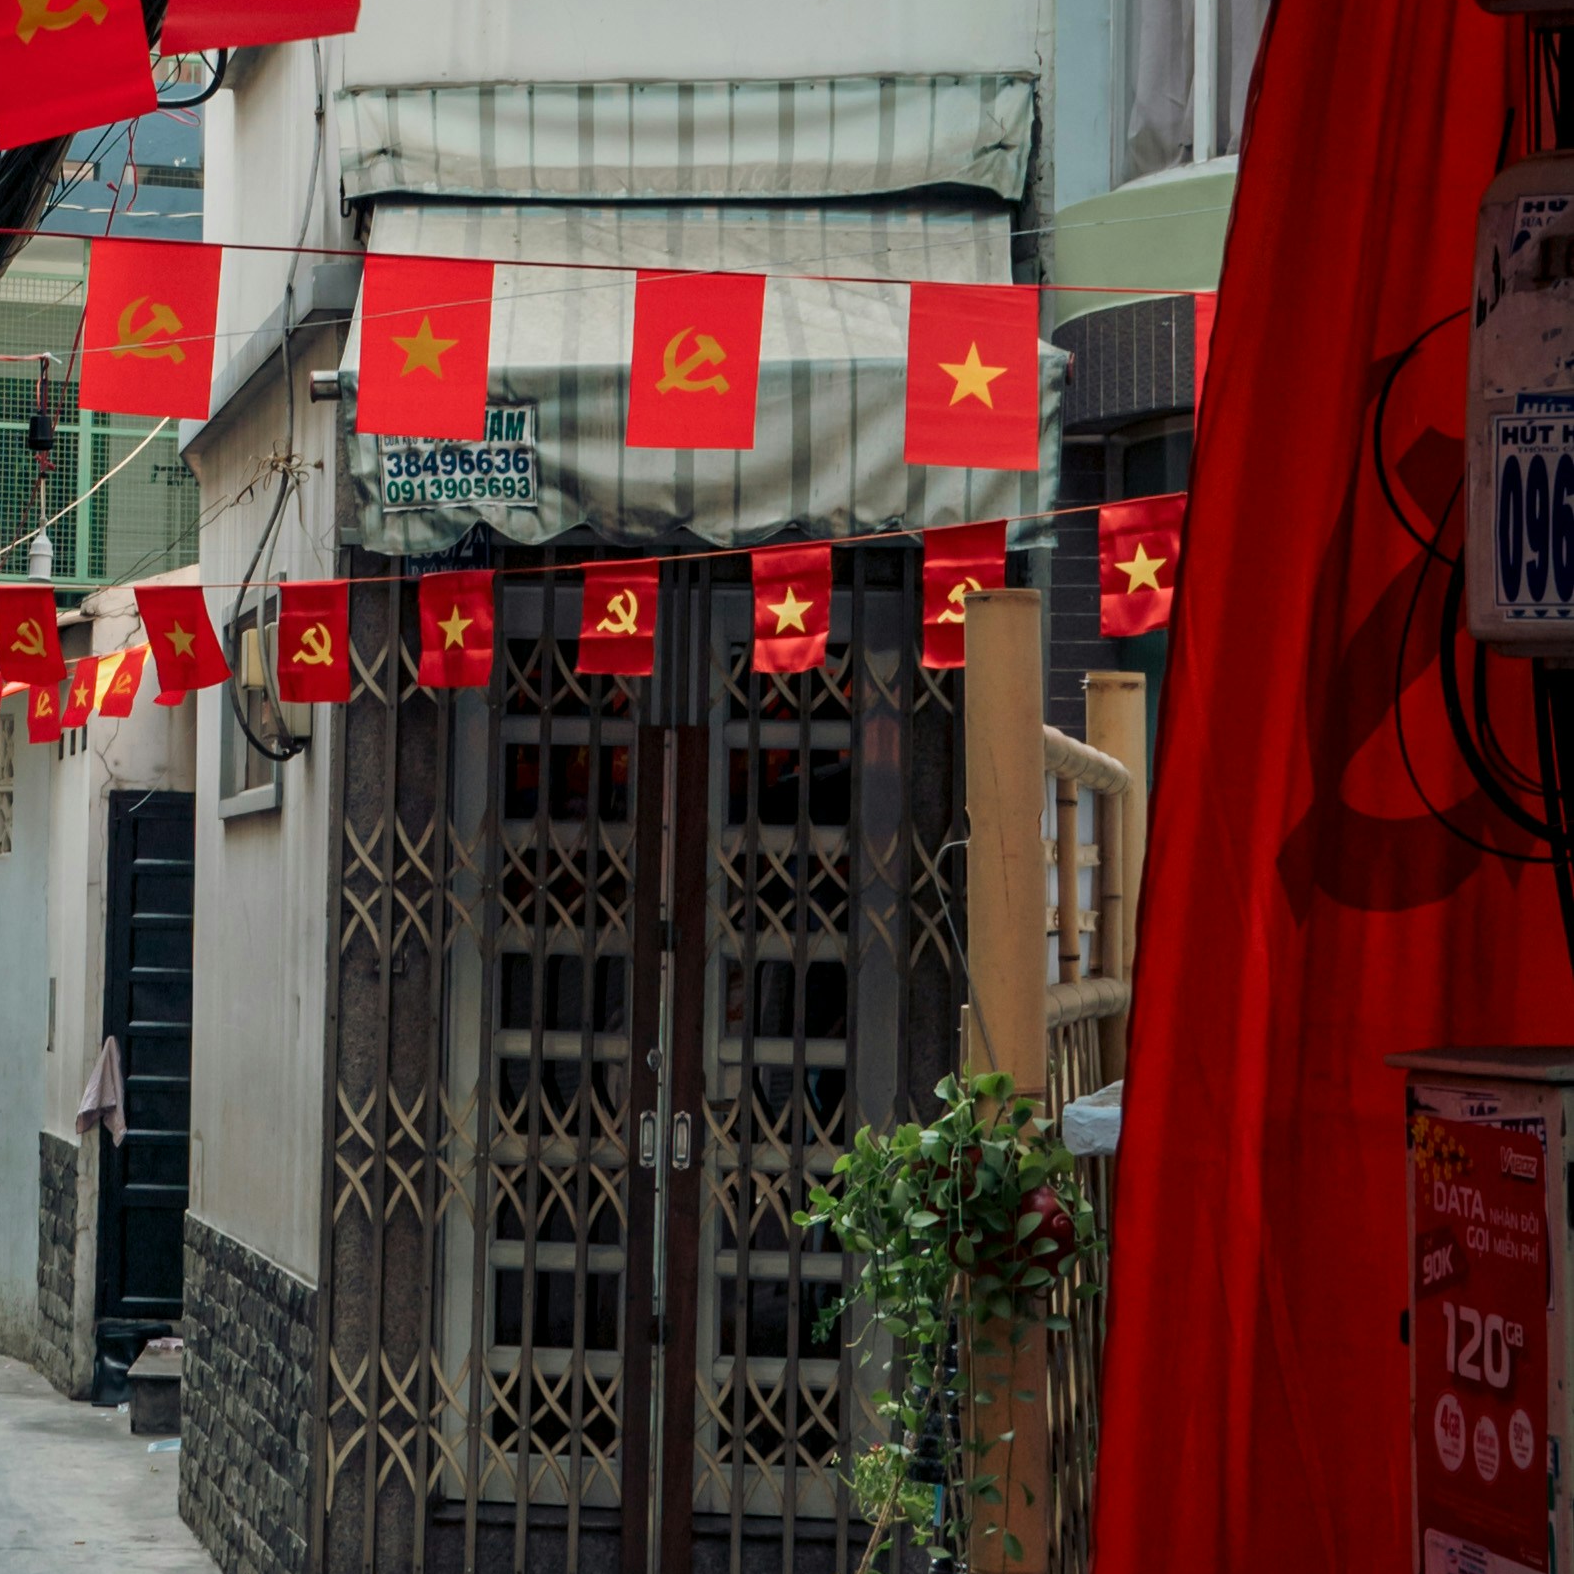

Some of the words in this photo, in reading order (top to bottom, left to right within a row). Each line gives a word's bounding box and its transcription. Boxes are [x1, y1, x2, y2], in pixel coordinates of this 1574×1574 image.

[1502, 421, 1554, 445] HÚT
[387, 448, 530, 478] 38496636
[387, 476, 531, 503] 0913905693
[1433, 1181, 1486, 1223] DATA
[1466, 1226, 1490, 1258] GỌI
[1423, 1242, 1454, 1286] 90K
